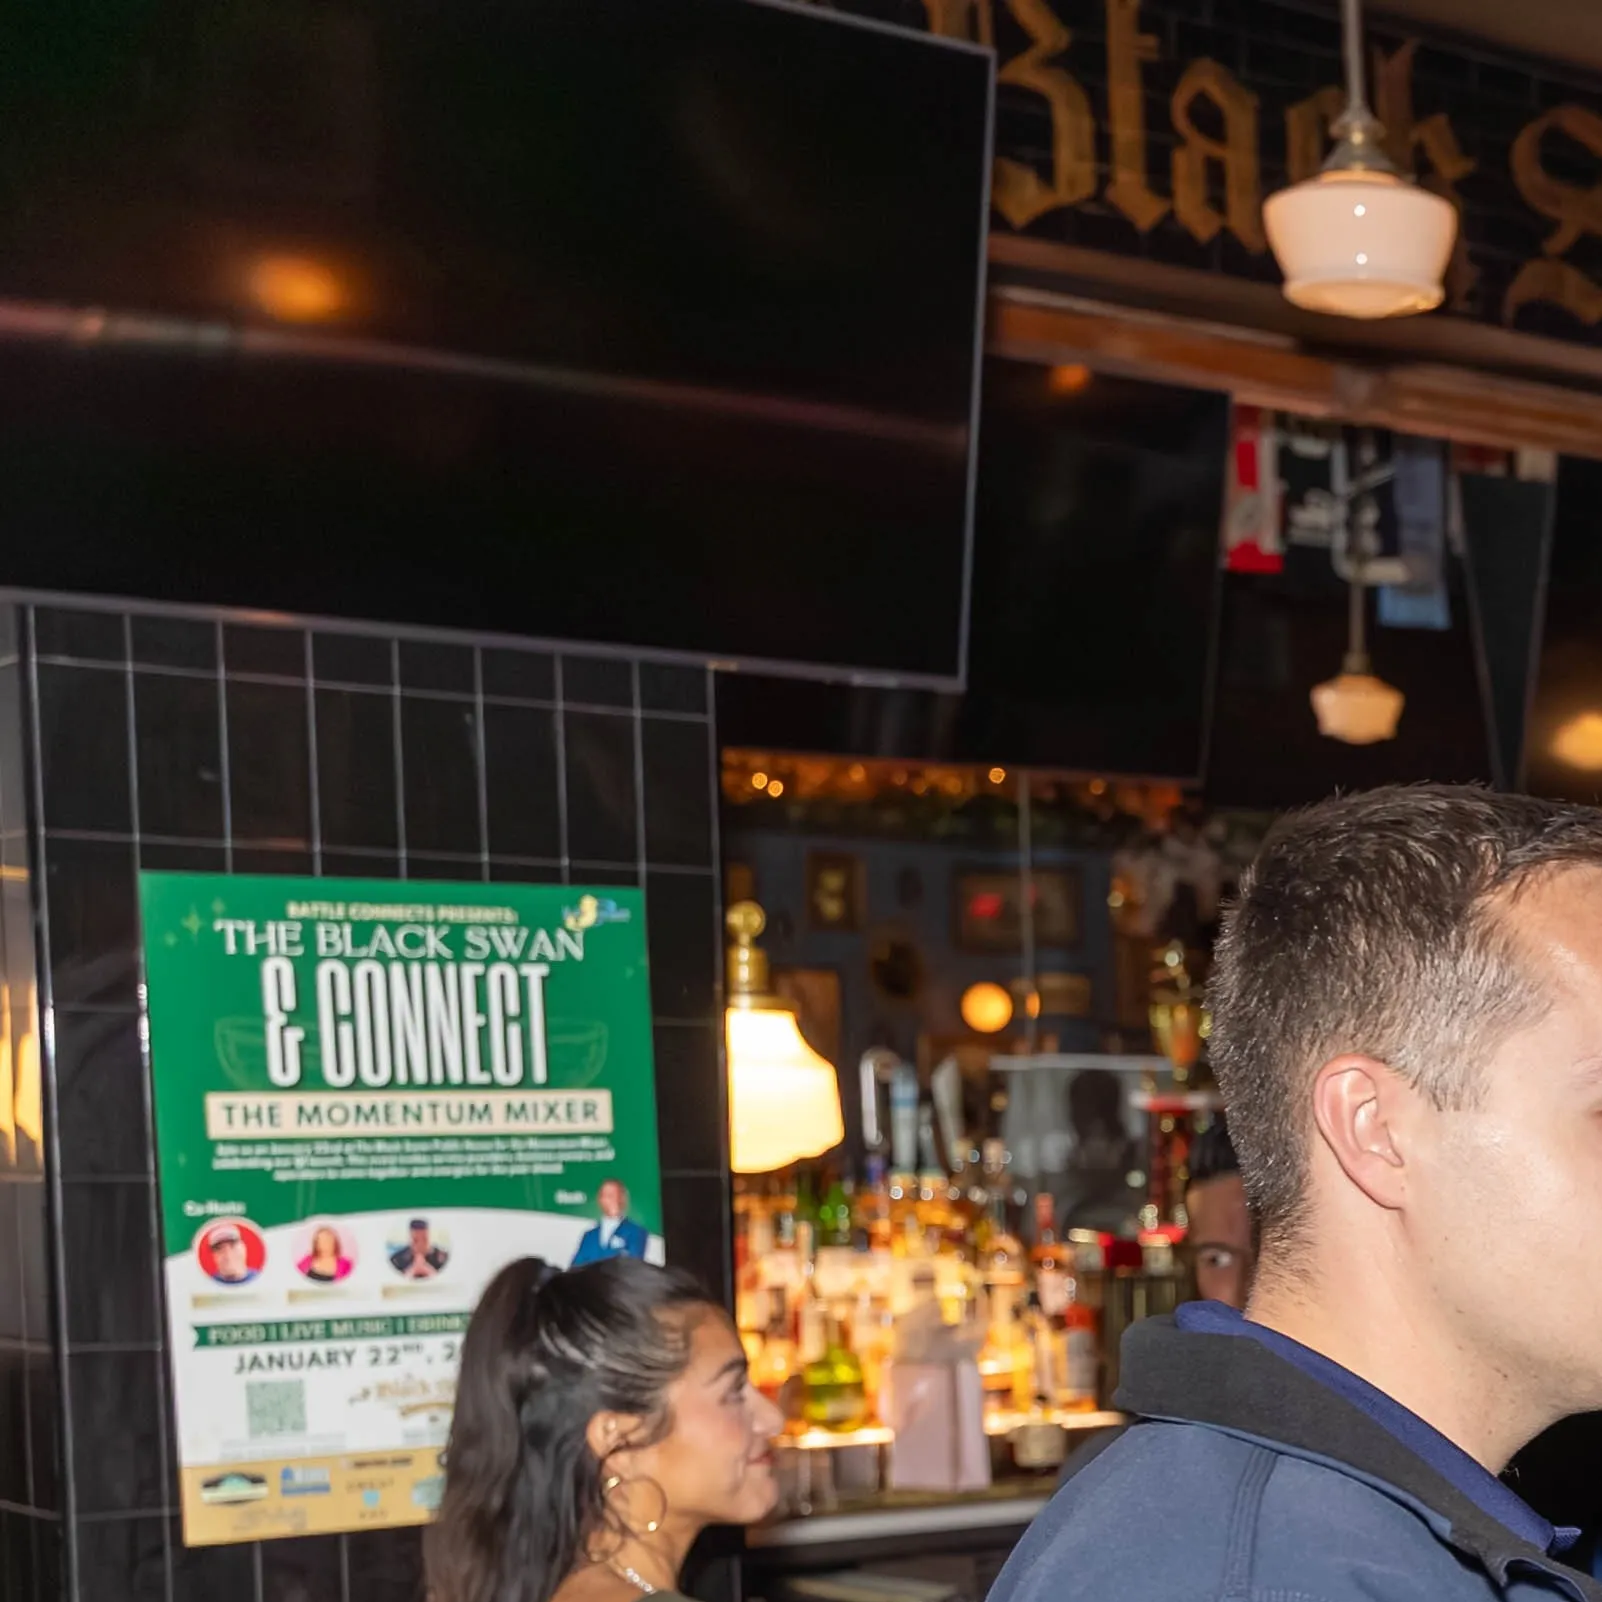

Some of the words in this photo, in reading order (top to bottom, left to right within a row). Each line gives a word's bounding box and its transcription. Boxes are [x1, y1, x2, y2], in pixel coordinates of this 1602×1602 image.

[213, 919, 305, 956] THE
[316, 921, 453, 959] BLACK
[464, 926, 585, 961] SWAN
[261, 956, 304, 1087] &
[316, 958, 549, 1087] CONNECT
[222, 1104, 282, 1129] THE
[297, 1101, 493, 1128] MOMENTUM
[504, 1099, 600, 1124] MIXER
[209, 1325, 266, 1344] FOOD
[281, 1321, 325, 1341] LIVE
[330, 1318, 392, 1338] MUSIC
[235, 1348, 356, 1375] JANUARY
